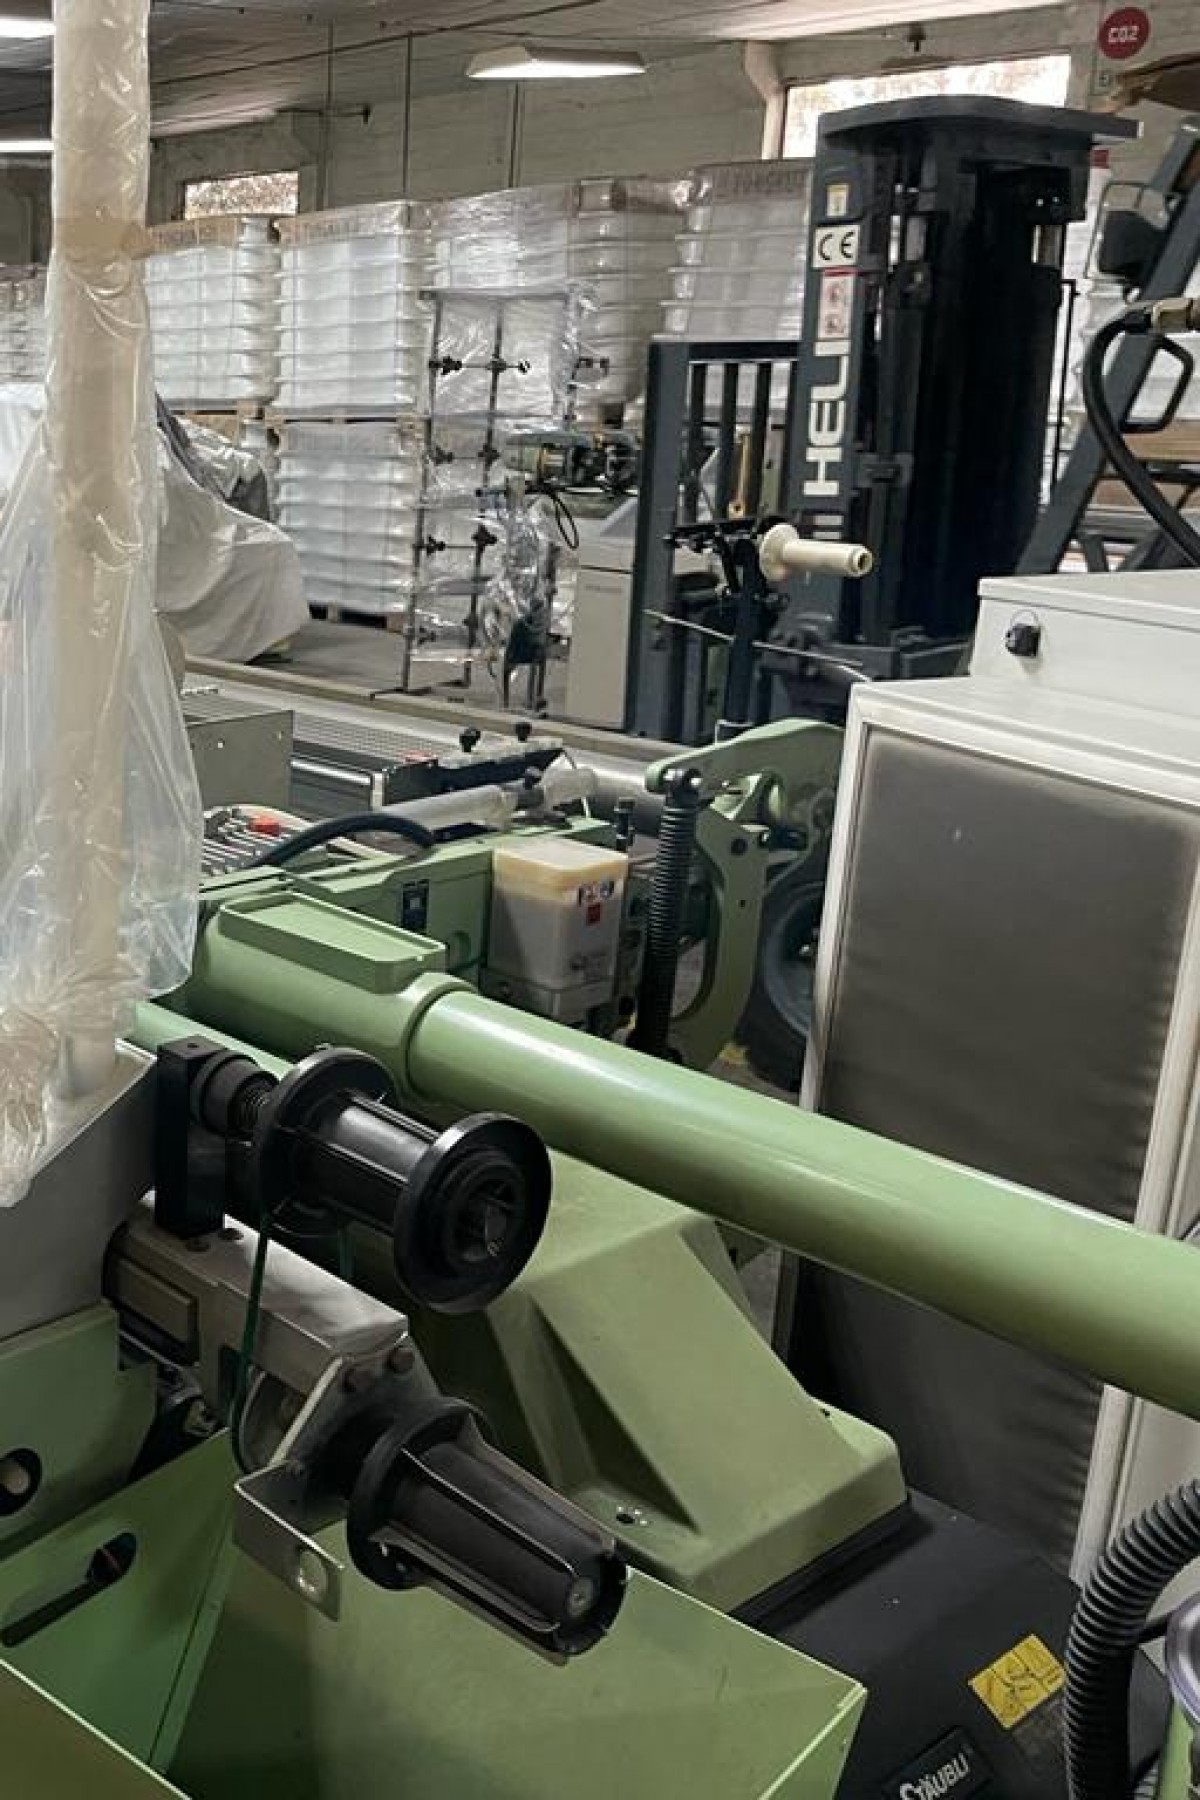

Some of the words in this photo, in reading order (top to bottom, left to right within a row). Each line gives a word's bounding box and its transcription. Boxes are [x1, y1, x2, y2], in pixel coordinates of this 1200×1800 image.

[1108, 25, 1139, 43] CO2
[818, 231, 855, 261] CE
[803, 341, 852, 496] HELI
